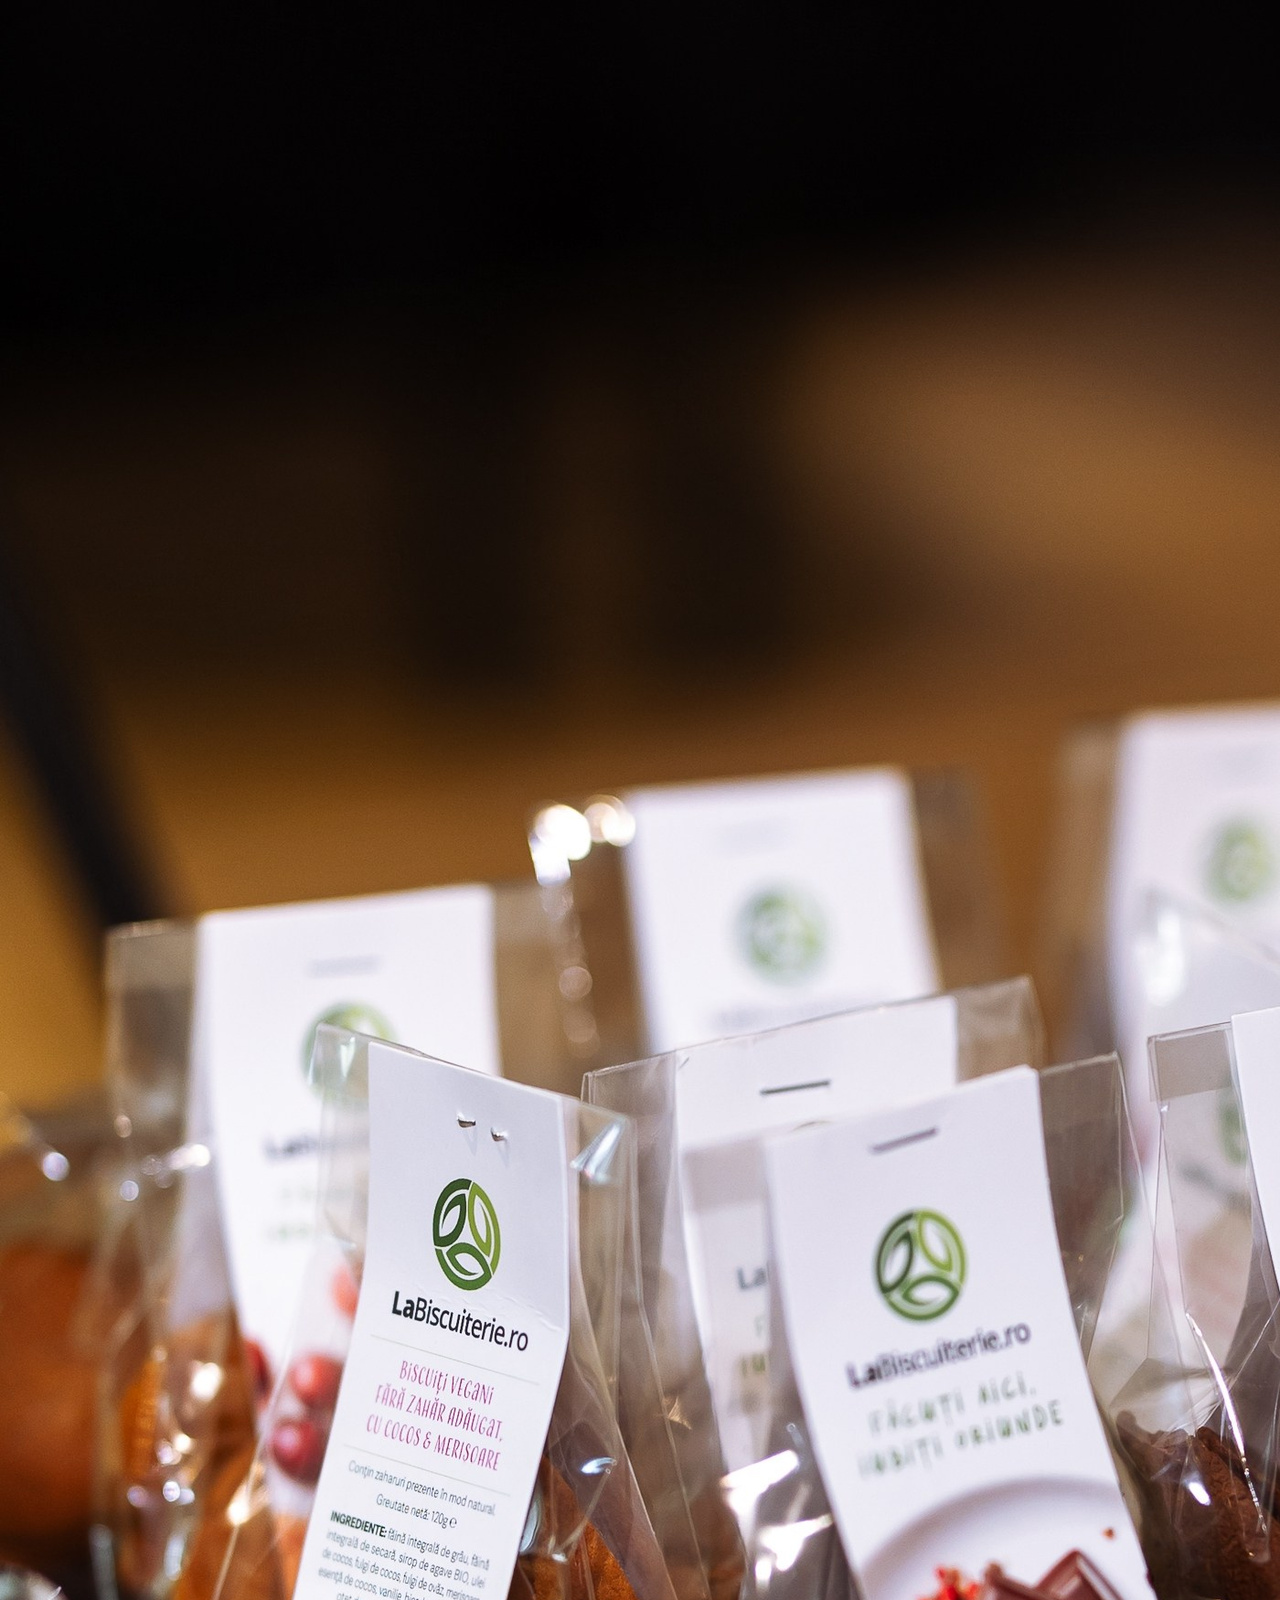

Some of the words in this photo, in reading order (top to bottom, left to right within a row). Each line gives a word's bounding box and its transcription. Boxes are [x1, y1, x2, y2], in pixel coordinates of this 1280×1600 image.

[392, 1290, 529, 1351] LaBiscuiterie.ro
[375, 1382, 406, 1410] FĂRĂ
[406, 1394, 446, 1423] ZAHĂR
[366, 1413, 382, 1434] CU
[384, 1419, 422, 1447] COCOS
[423, 1431, 432, 1449] &
[375, 1468, 407, 1488] zaharuri
[406, 1480, 439, 1498] prezente
[449, 1492, 468, 1507] mod
[376, 1493, 410, 1514] Greutate
[410, 1505, 431, 1521] netă:
[431, 1510, 449, 1529] 120g
[330, 1510, 388, 1538] INGREDIENTE:
[407, 1534, 440, 1554] integrală
[440, 1545, 451, 1559] de
[359, 1540, 371, 1553] de
[371, 1545, 397, 1562] secară,
[398, 1552, 418, 1569] sirop
[418, 1558, 430, 1571] de
[430, 1564, 453, 1578] agave
[370, 1562, 380, 1575] de
[380, 1567, 402, 1583] cocos,
[402, 1571, 419, 1590] fulgi
[418, 1577, 428, 1590] de
[343, 1573, 354, 1586] de
[354, 1579, 378, 1595] cocos,
